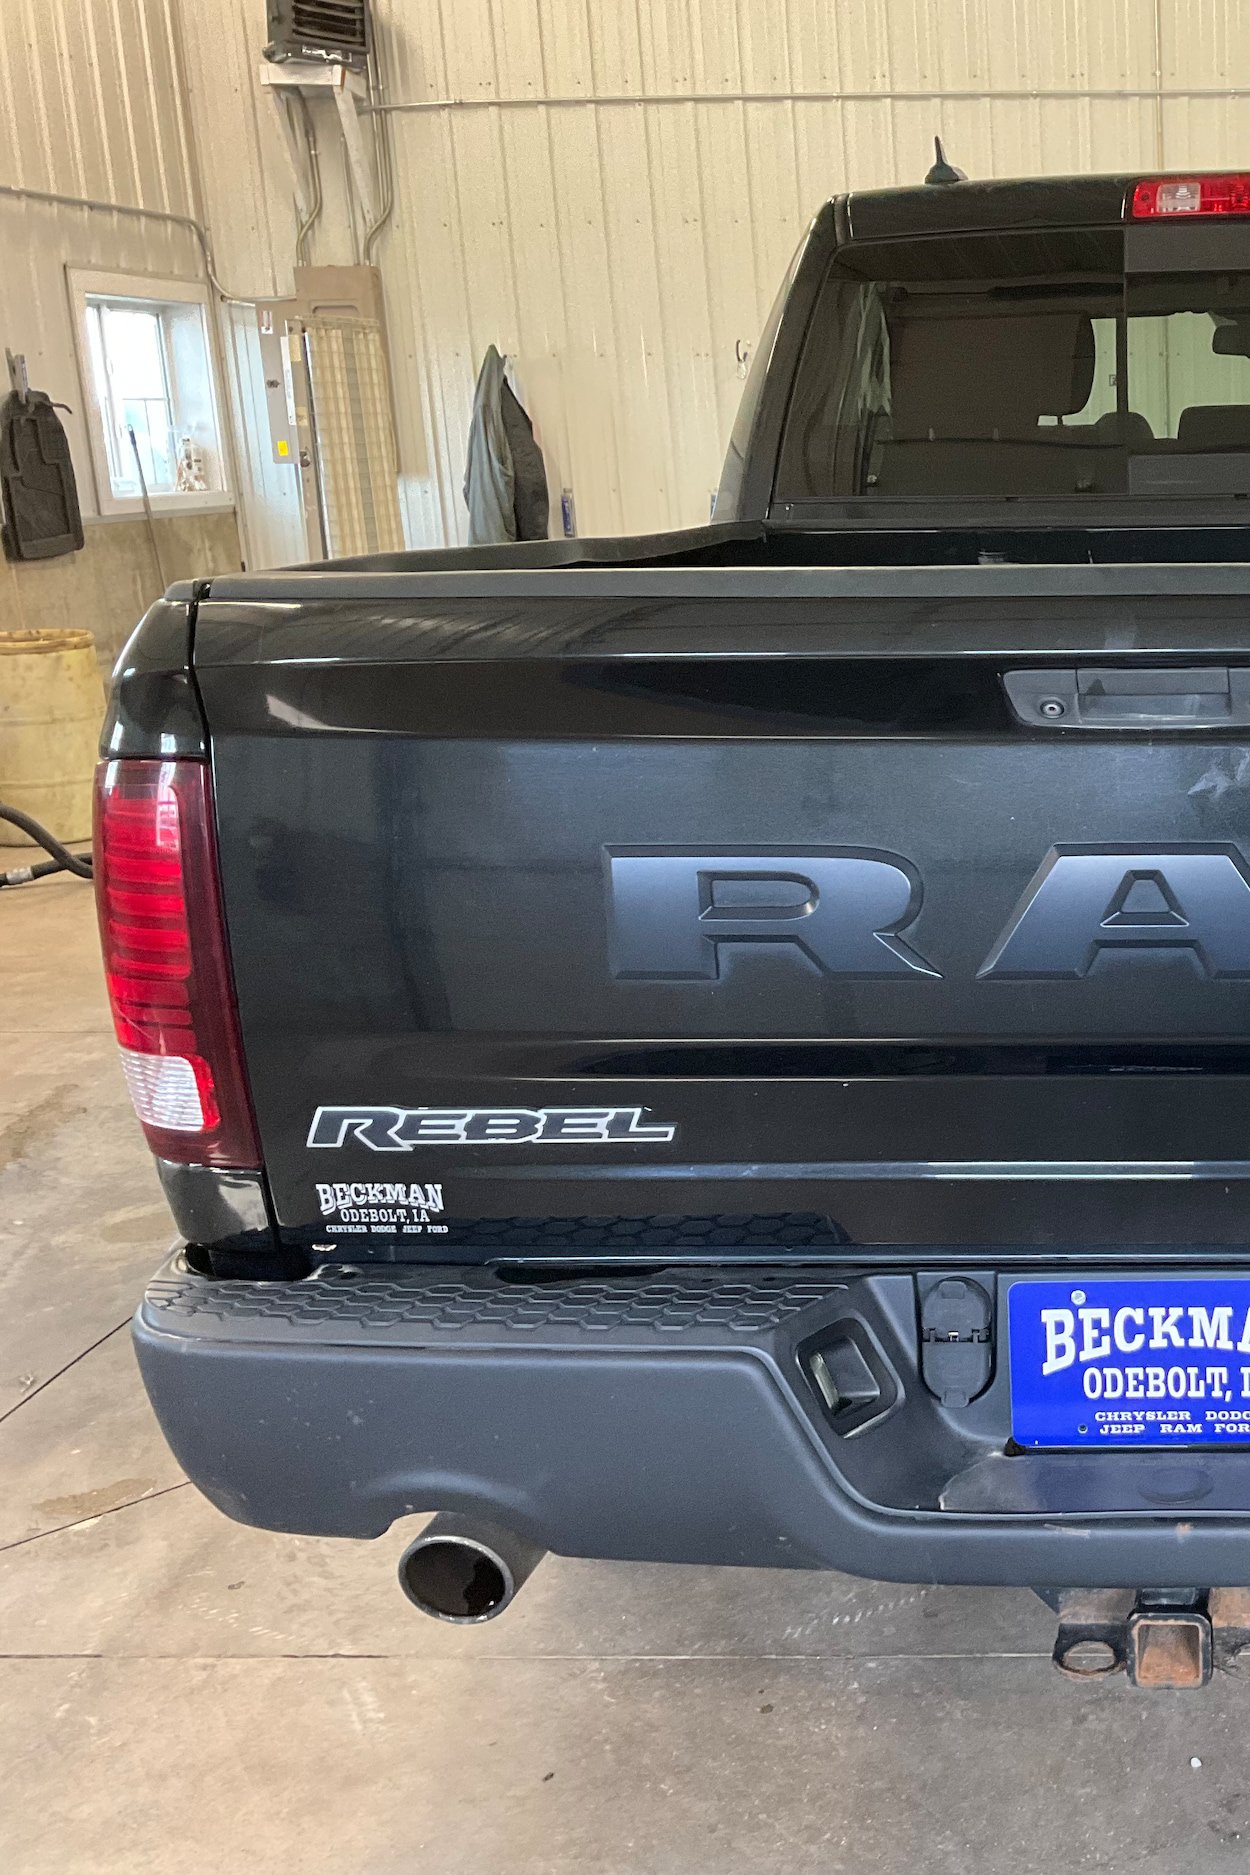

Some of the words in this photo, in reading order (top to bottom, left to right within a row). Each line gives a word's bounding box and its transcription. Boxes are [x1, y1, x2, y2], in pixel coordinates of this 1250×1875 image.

[306, 1105, 678, 1152] REBEL
[315, 1183, 445, 1216] BECKMAN
[340, 1208, 410, 1225] ODEBOLT,
[412, 1208, 431, 1223] IA
[370, 1224, 397, 1234] DODGE
[426, 1224, 449, 1234] FORD
[1083, 1366, 1232, 1402] ODEBOLT,
[1094, 1410, 1192, 1422] CHRYSLER
[1099, 1423, 1146, 1435] JEEP
[1159, 1423, 1203, 1434] RAM
